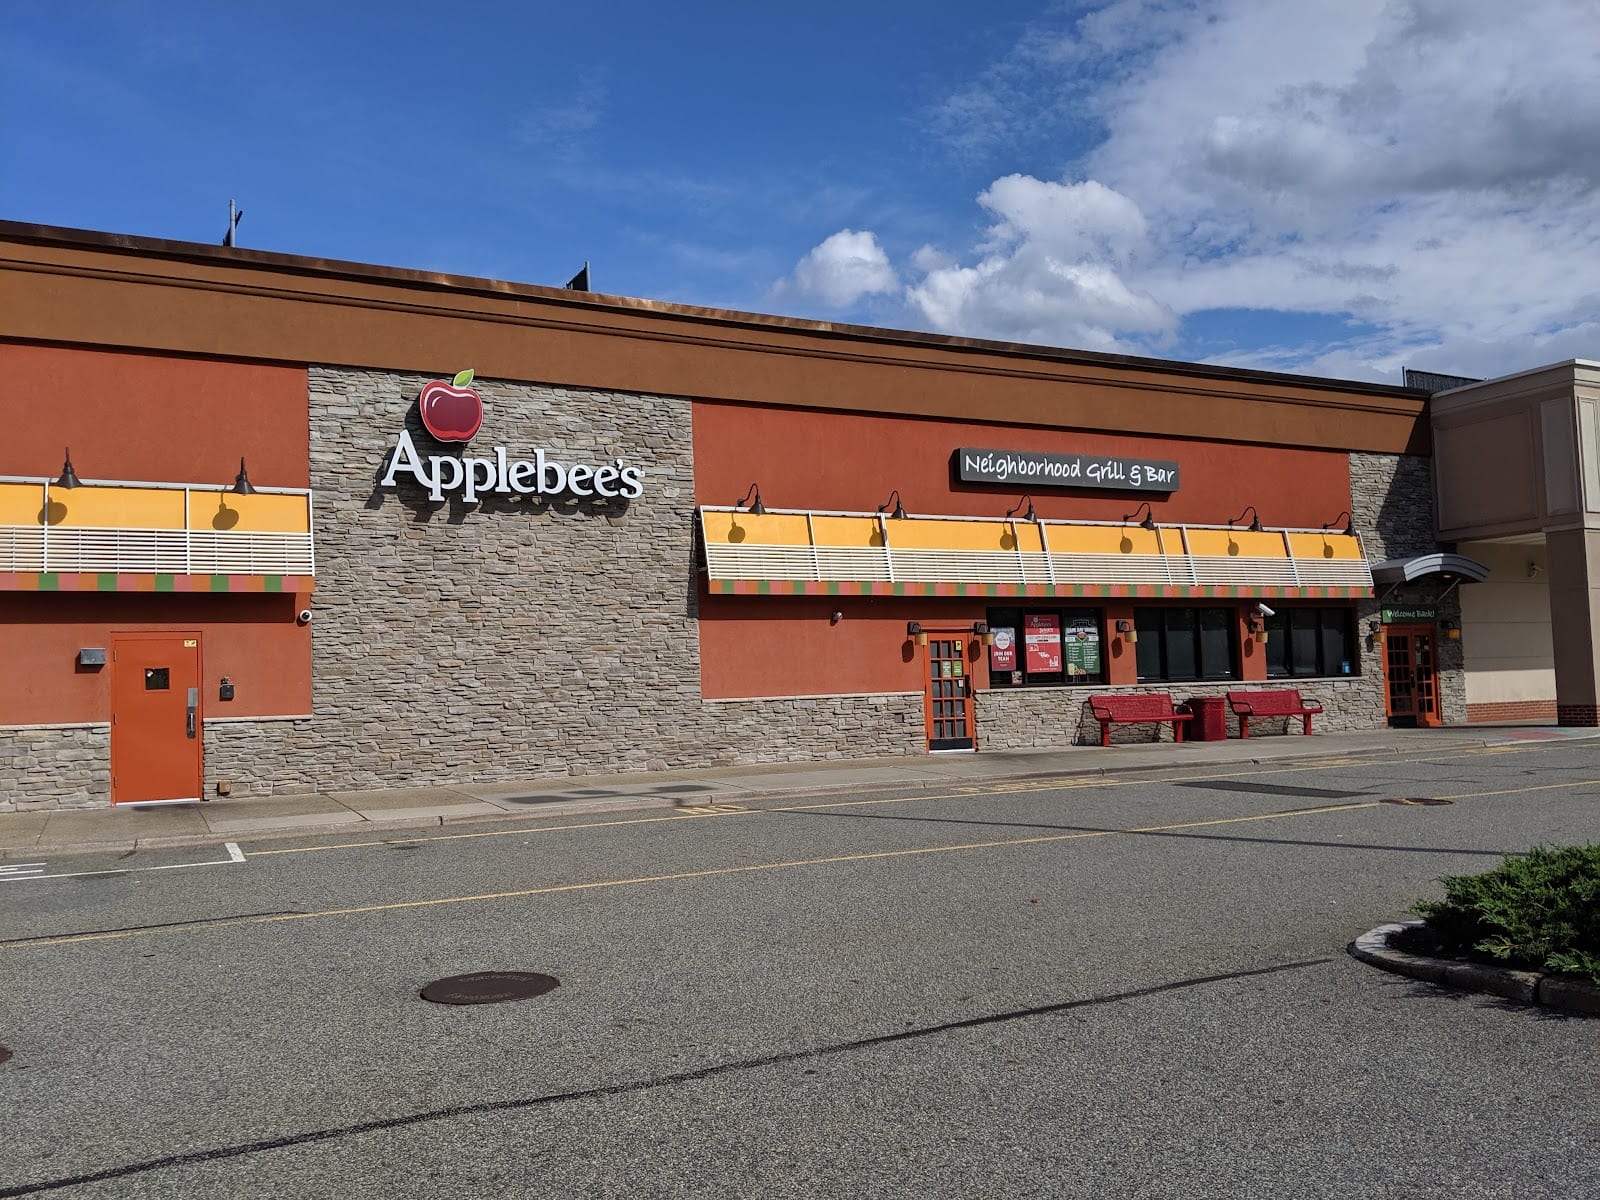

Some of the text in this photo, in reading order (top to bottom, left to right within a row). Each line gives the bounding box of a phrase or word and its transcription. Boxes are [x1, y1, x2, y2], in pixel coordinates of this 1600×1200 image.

[381, 429, 646, 503] Applebee's
[965, 453, 1176, 486] Neighborhood Grill & Bar
[1387, 609, 1415, 618] Welcome
